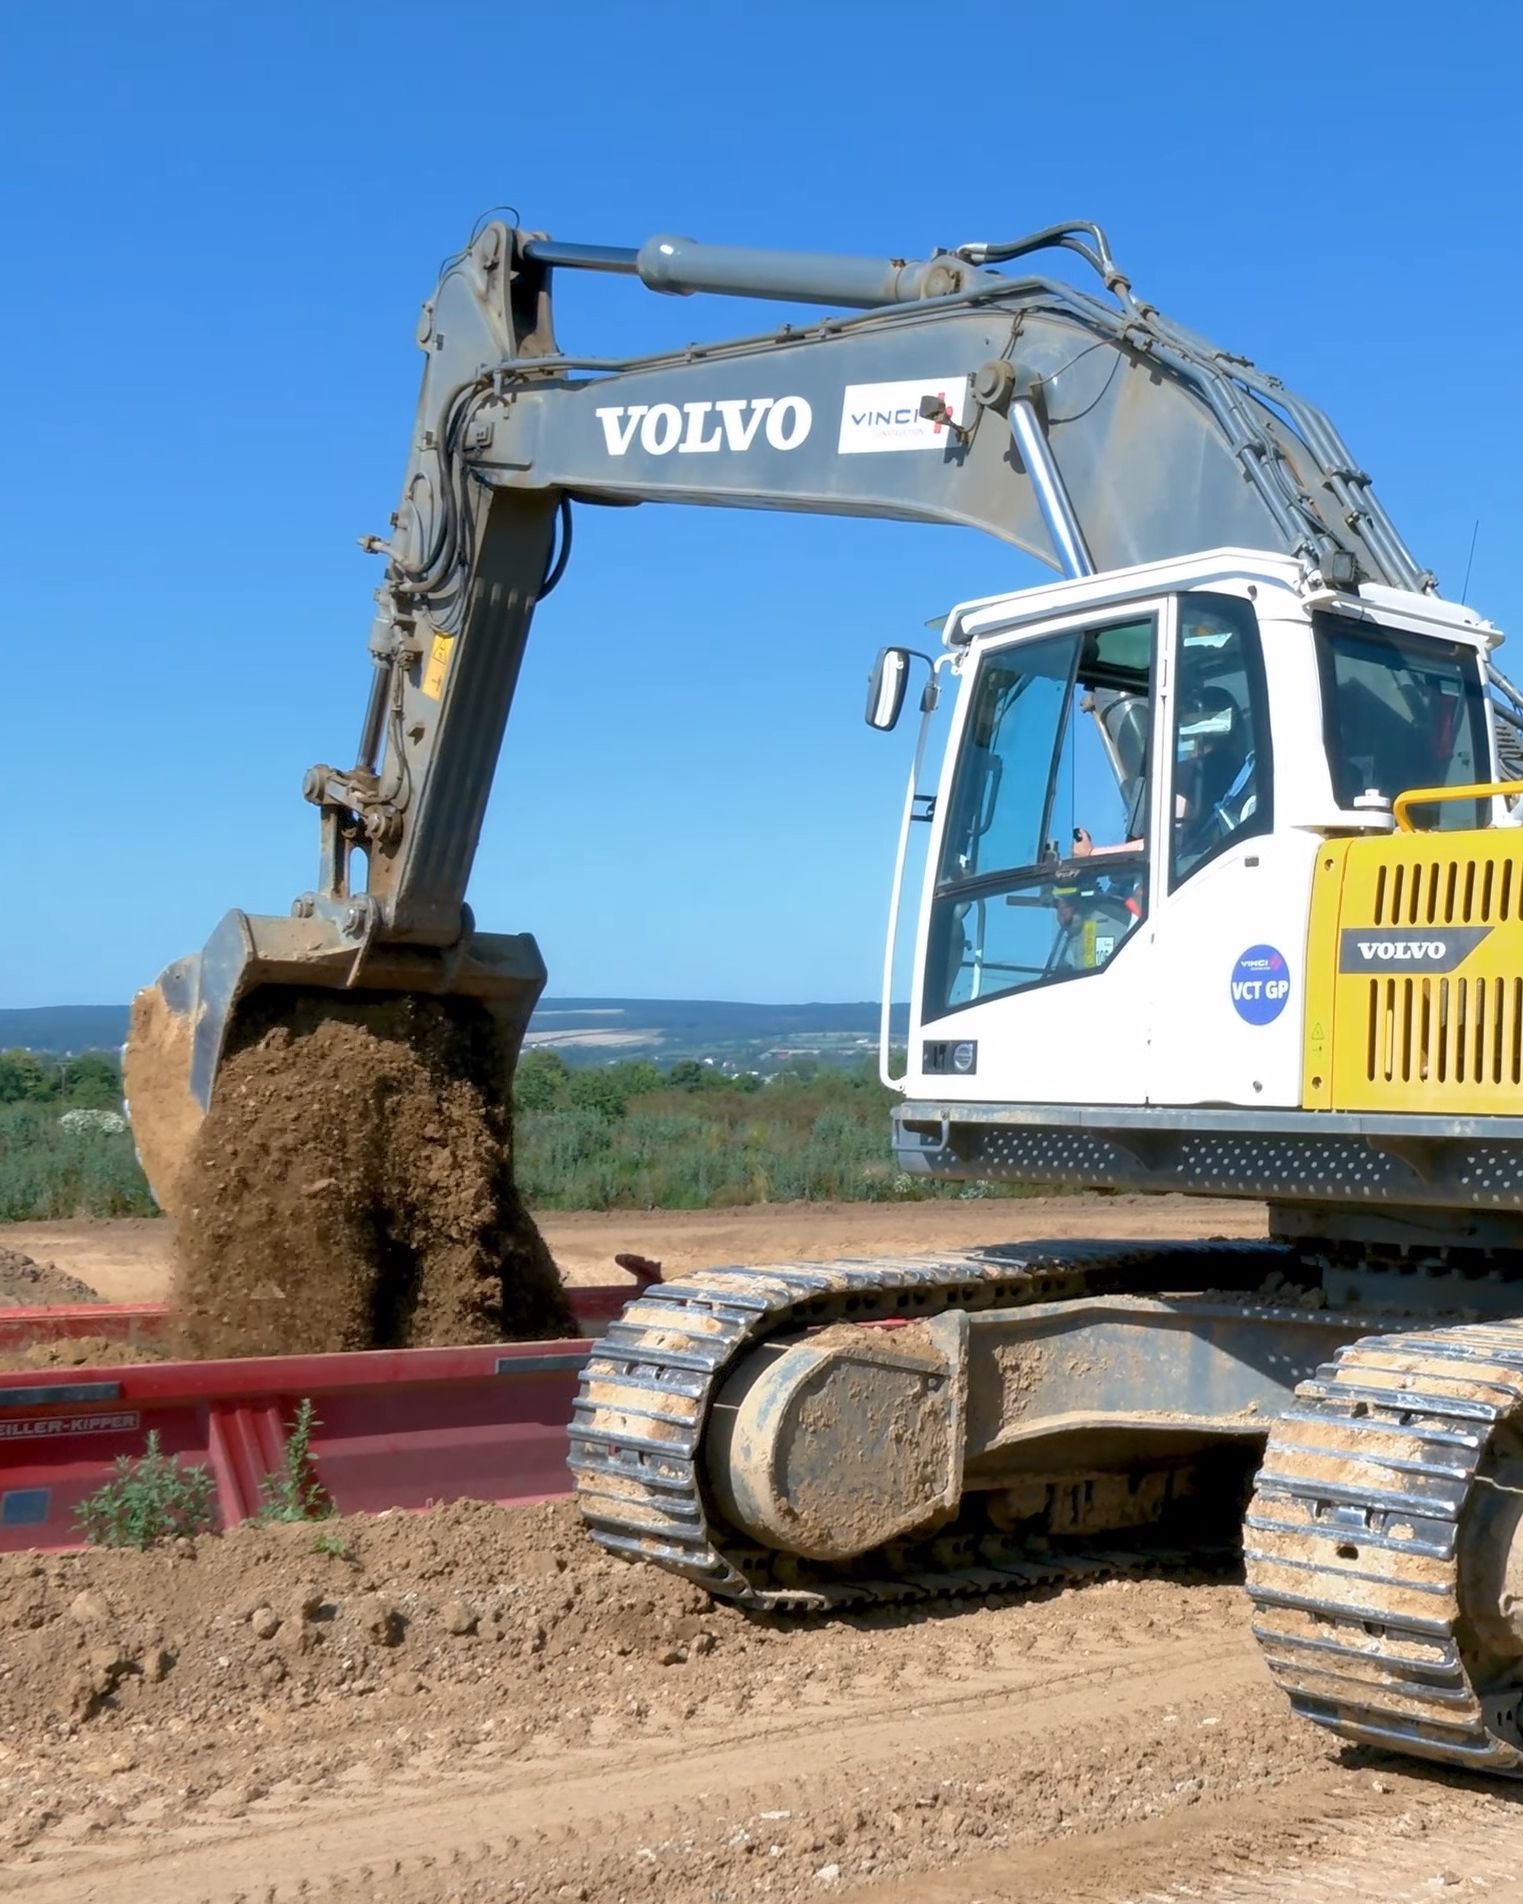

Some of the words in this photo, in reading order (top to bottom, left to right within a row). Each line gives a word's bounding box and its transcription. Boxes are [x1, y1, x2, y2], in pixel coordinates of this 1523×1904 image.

[595, 396, 812, 456] VOLVO
[851, 408, 919, 426] VINCI
[1357, 941, 1446, 960] VOLVO
[1232, 981, 1263, 1001] VCT
[1265, 980, 1289, 1000] GP
